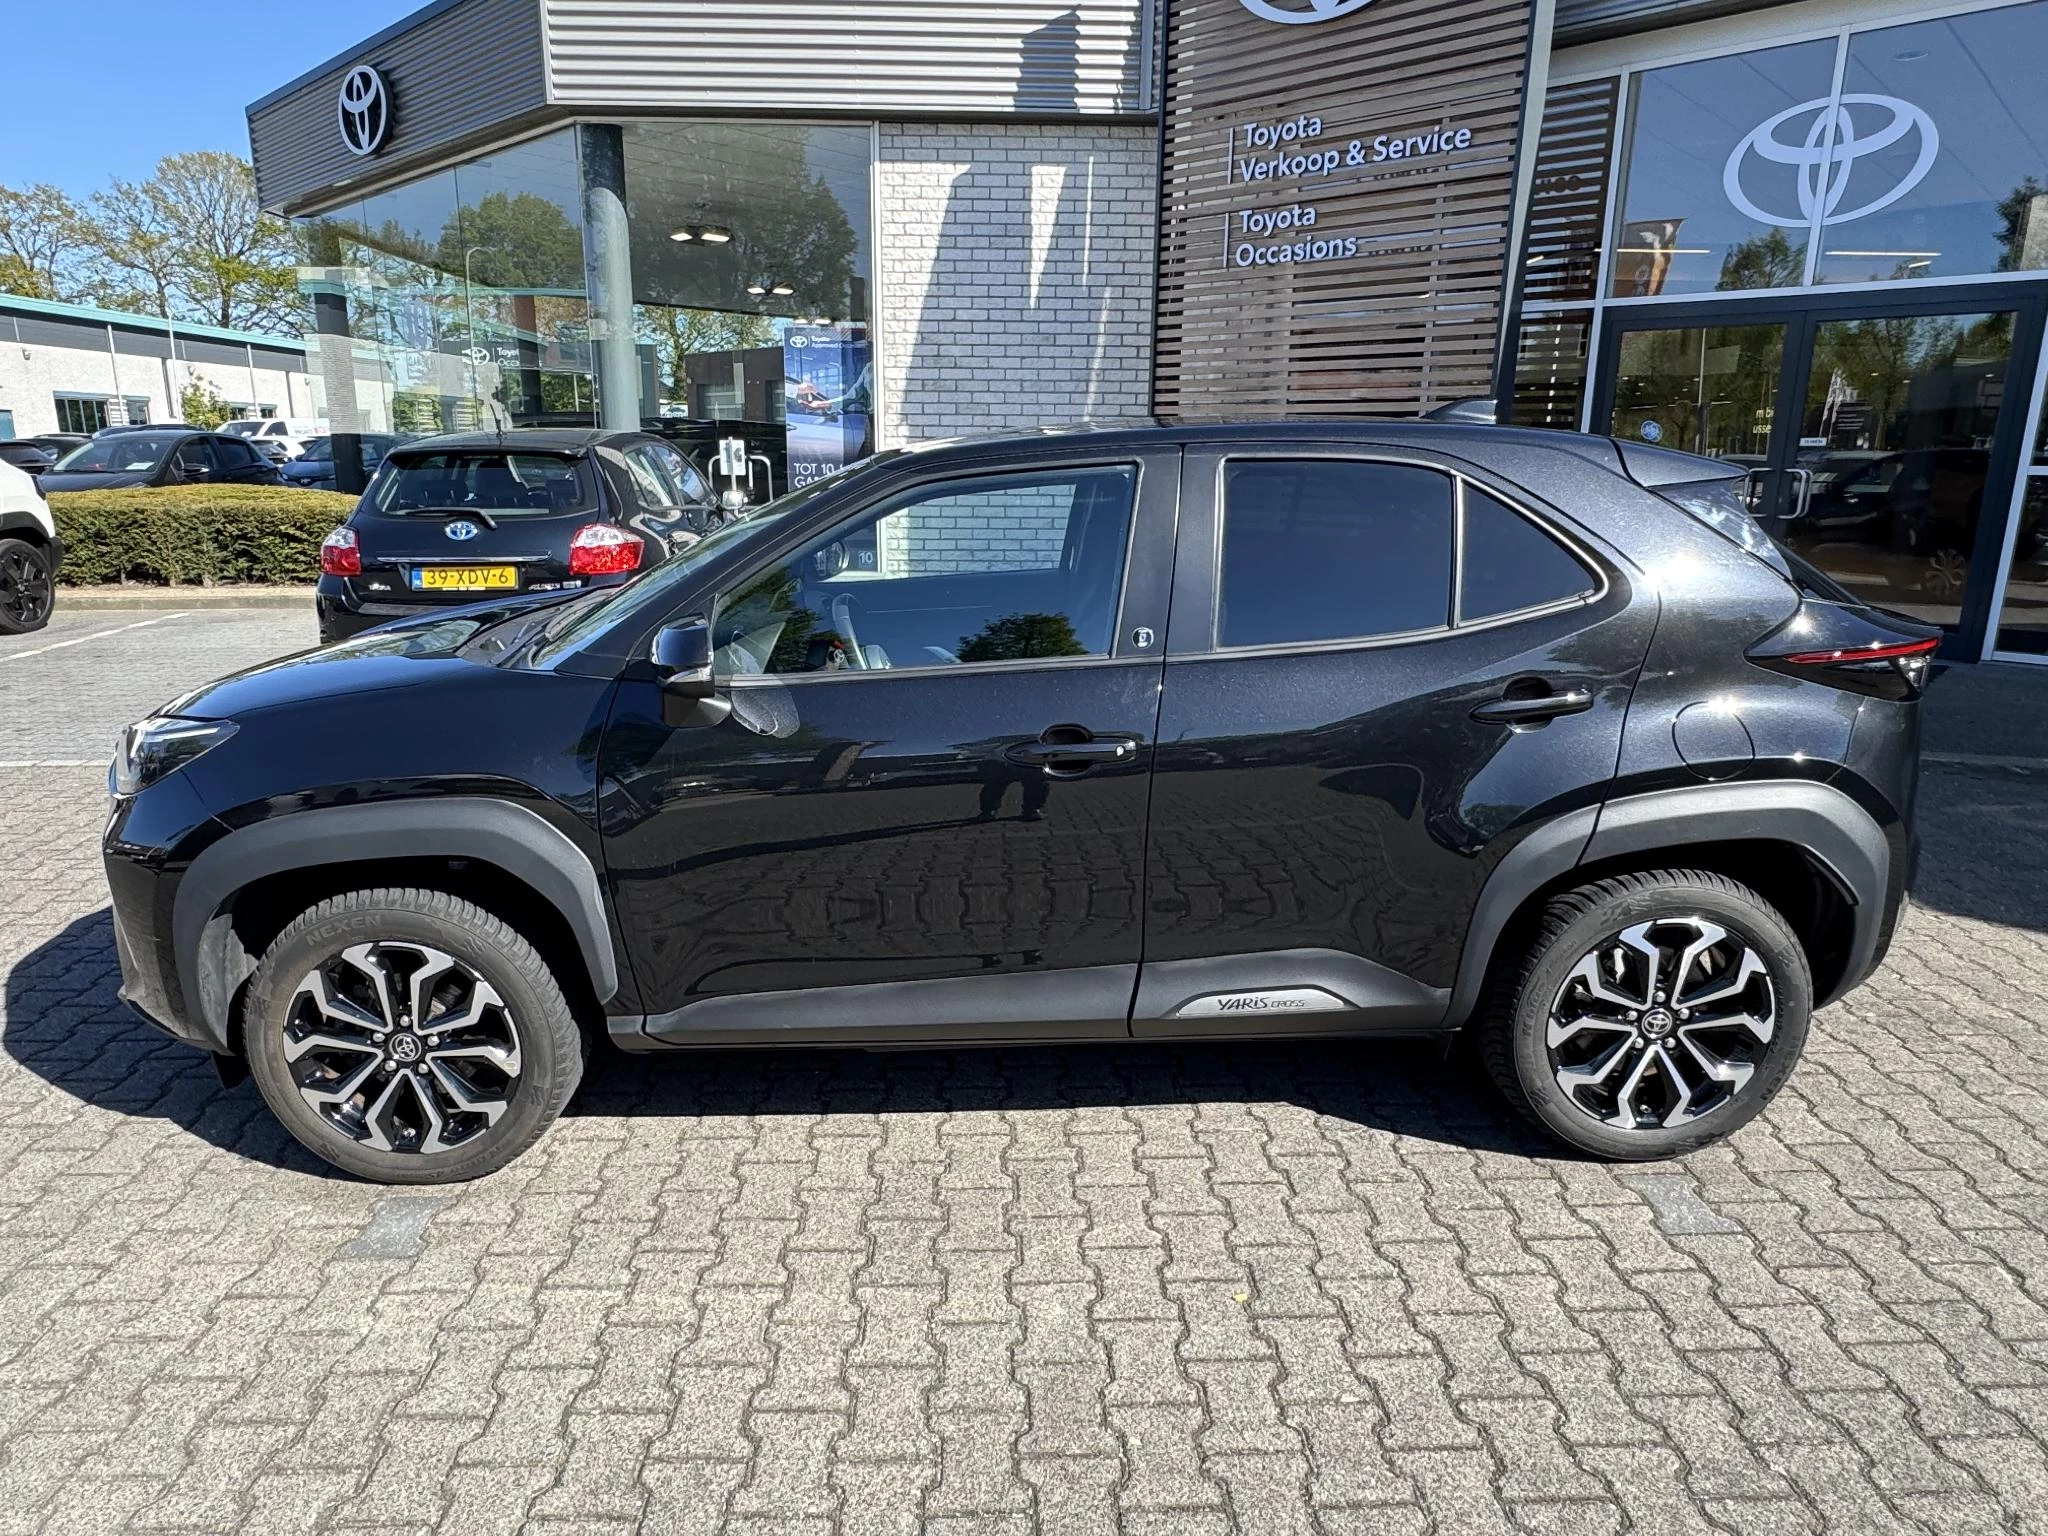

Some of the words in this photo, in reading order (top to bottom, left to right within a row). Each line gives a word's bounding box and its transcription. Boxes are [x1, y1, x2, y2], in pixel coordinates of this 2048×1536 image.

[1243, 115, 1322, 150] Toyota
[1240, 150, 1340, 182] Verkoop
[1345, 139, 1366, 166] &
[1372, 125, 1472, 162] Service
[1239, 204, 1316, 237] Toyota
[1236, 235, 1357, 267] Occasions
[794, 463, 817, 475] TOT
[821, 463, 834, 475] 10
[859, 551, 873, 564] 10
[427, 568, 509, 585] 39-XDV-6
[305, 915, 381, 946] NEXEN
[1270, 1000, 1305, 1008] CROSS
